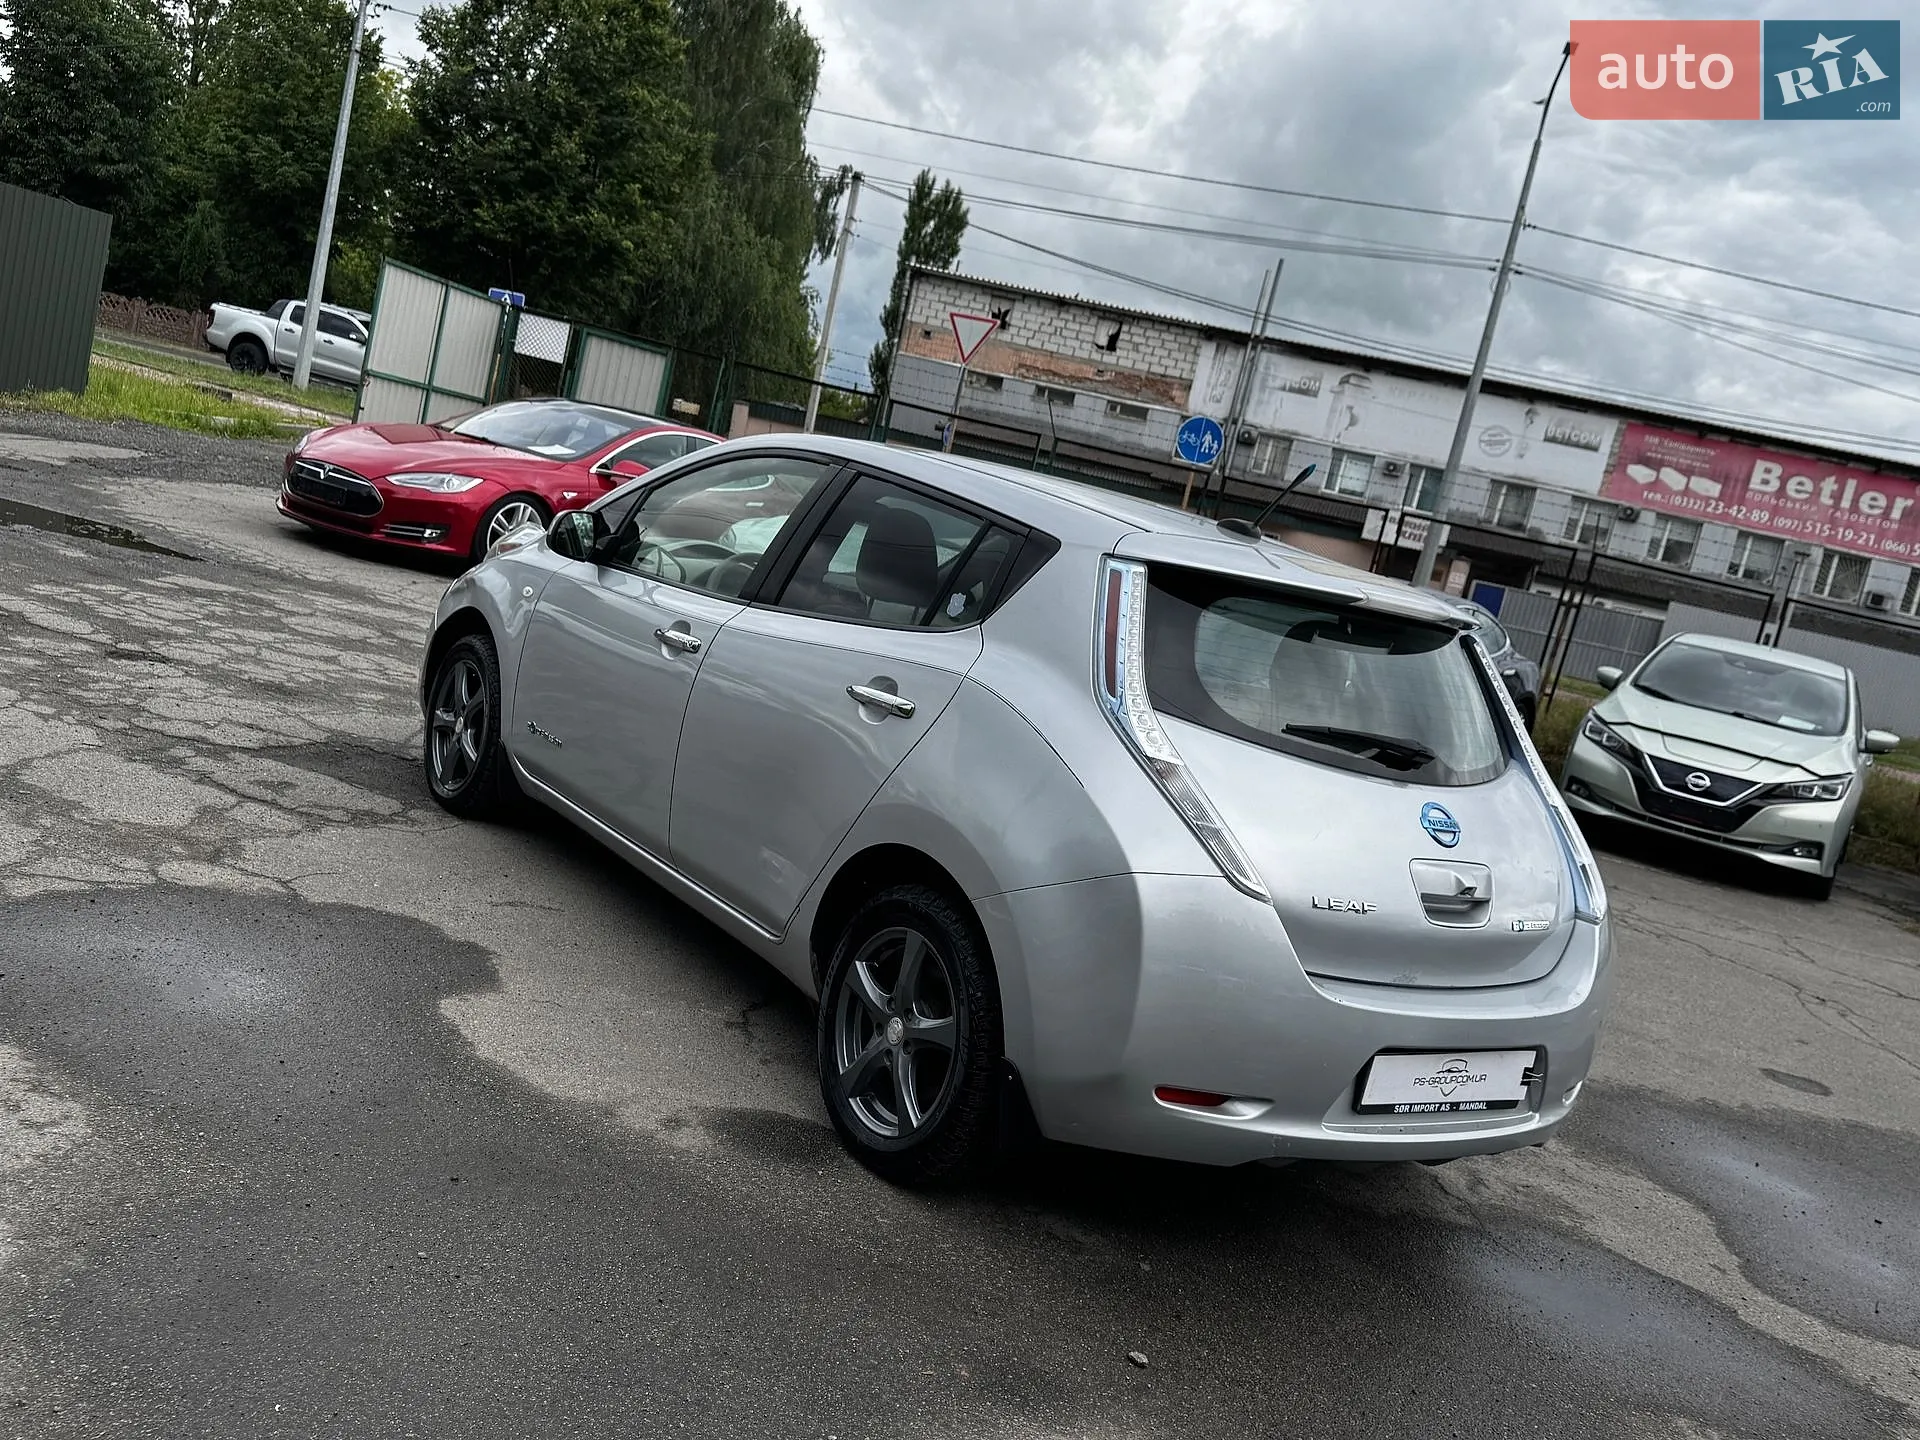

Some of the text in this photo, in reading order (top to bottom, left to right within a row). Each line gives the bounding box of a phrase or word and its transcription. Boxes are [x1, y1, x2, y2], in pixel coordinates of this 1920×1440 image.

[1748, 459, 1914, 521] Betler
[1311, 896, 1377, 914] LEAF
[1394, 1104, 1410, 1114] SØR
[1411, 1103, 1439, 1113] IMPORT
[1440, 1102, 1450, 1112] AS
[1459, 1101, 1487, 1111] MANDAL
